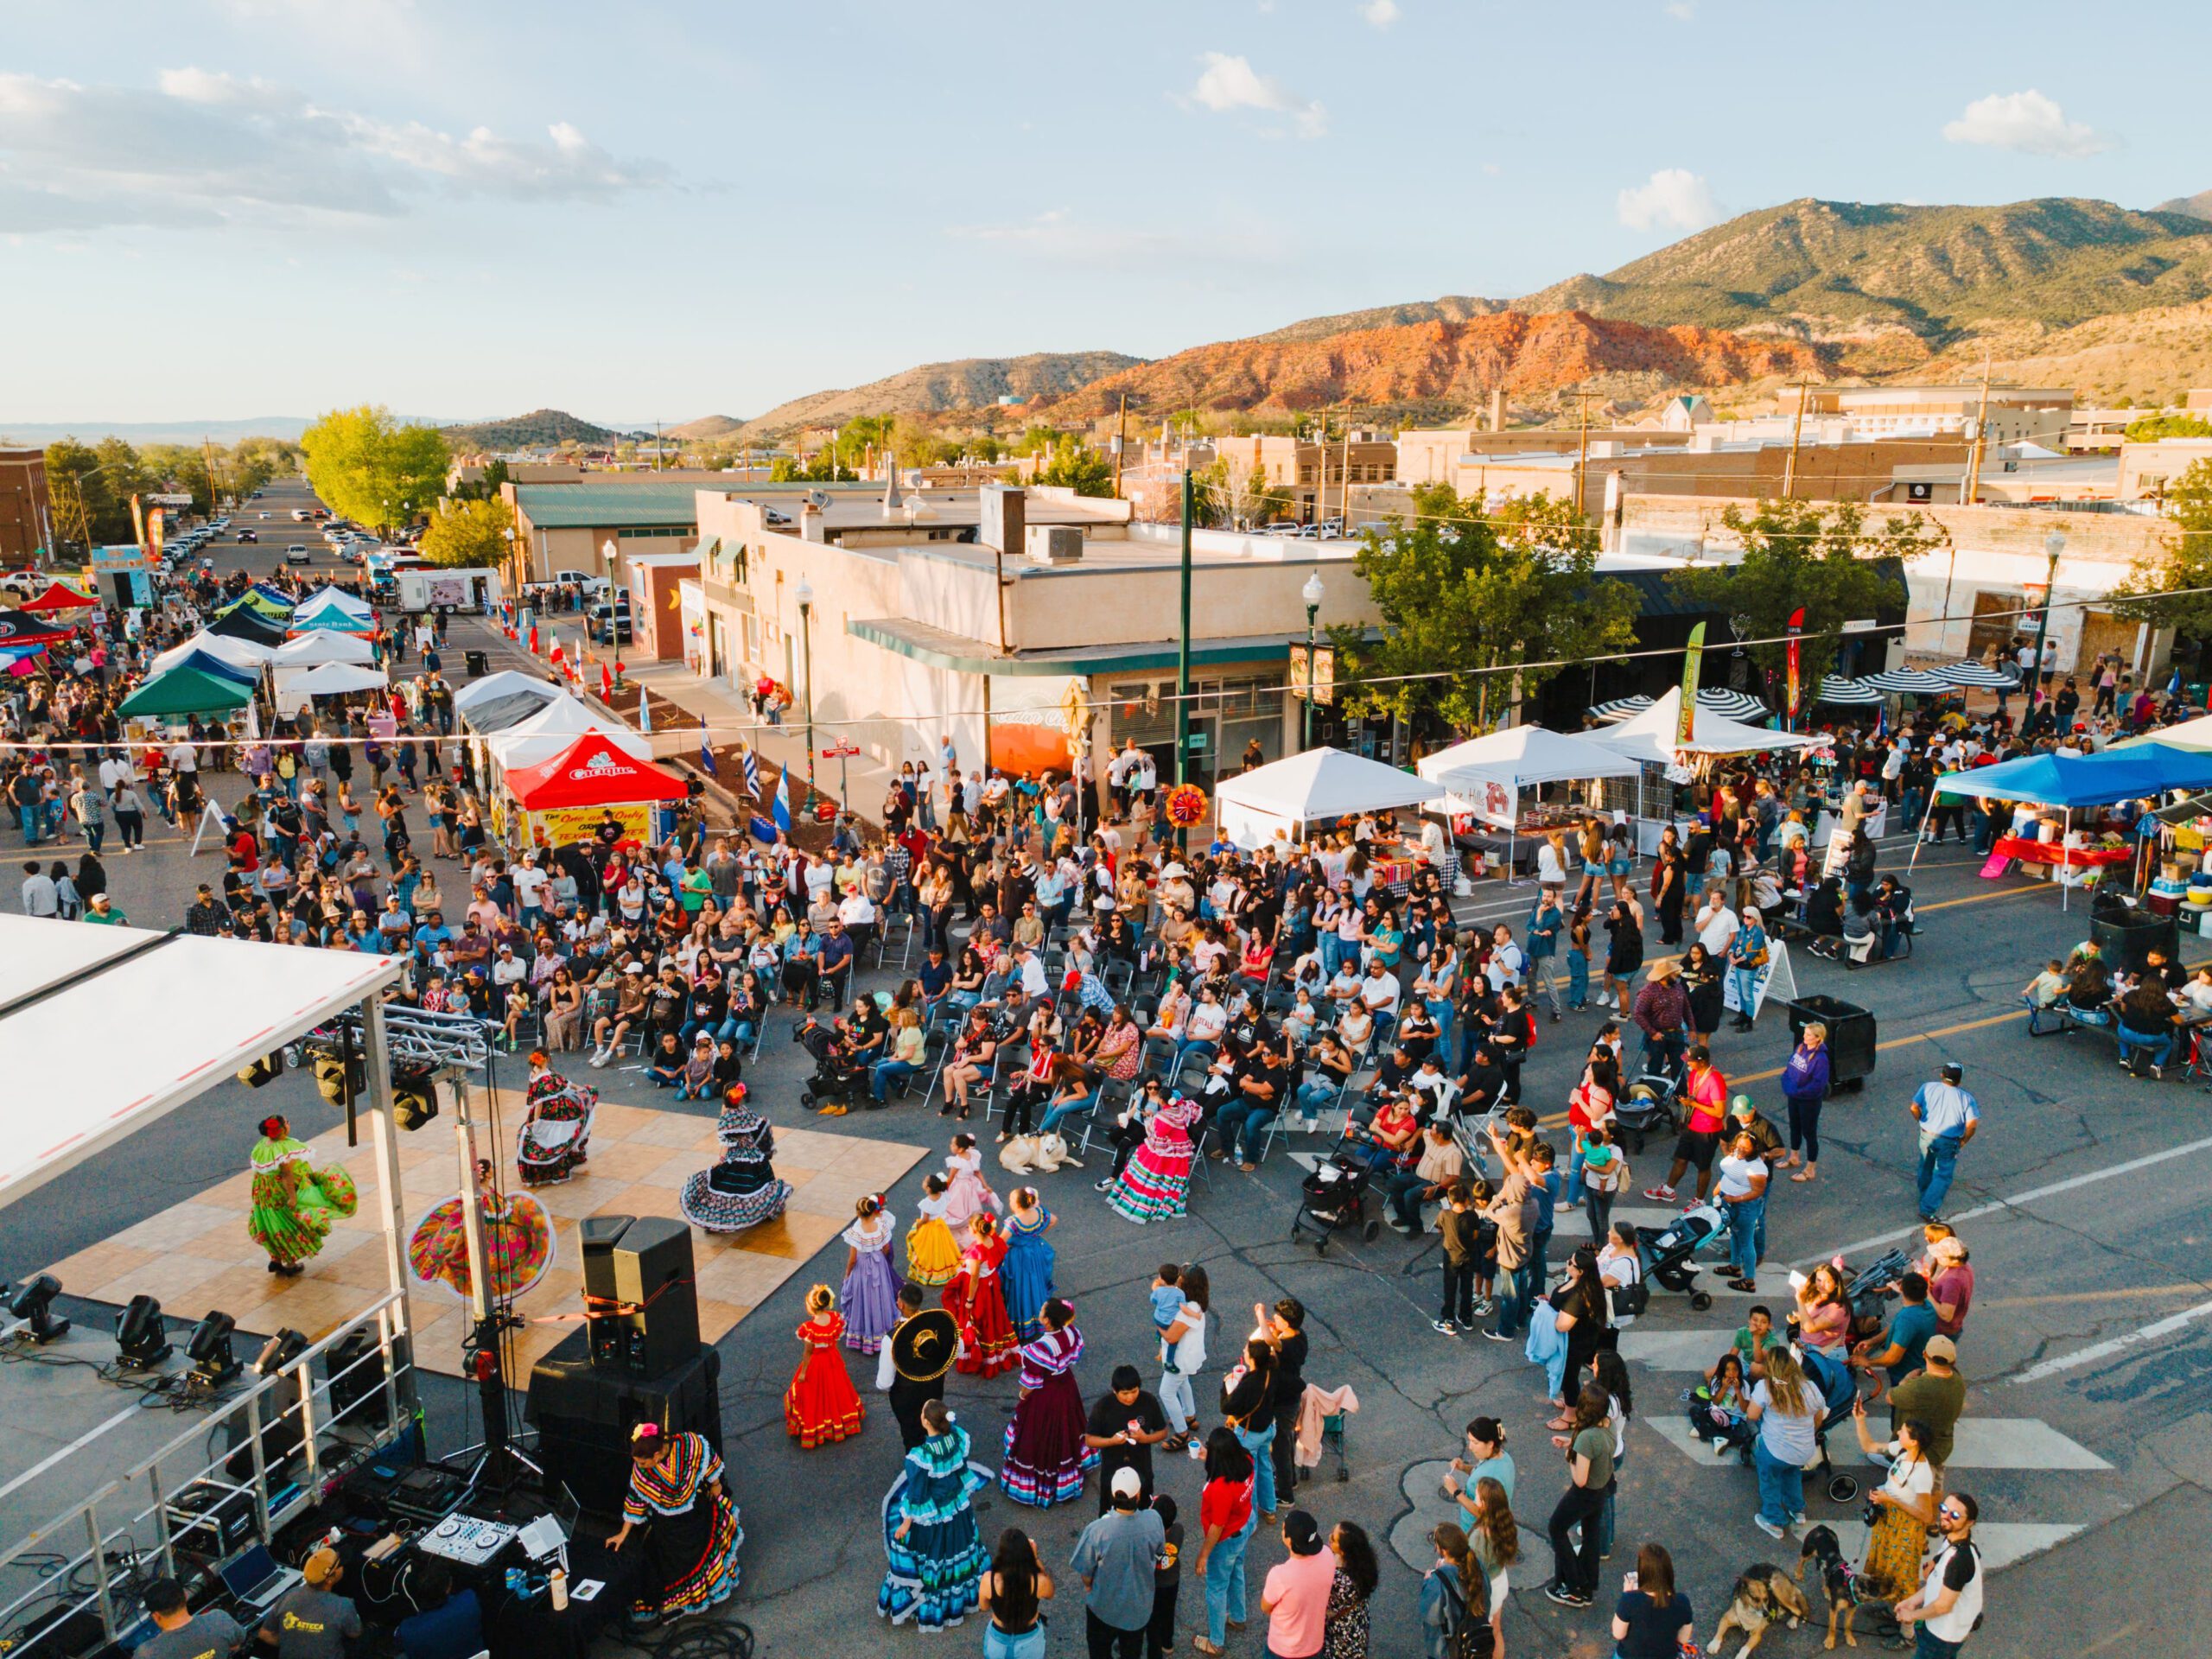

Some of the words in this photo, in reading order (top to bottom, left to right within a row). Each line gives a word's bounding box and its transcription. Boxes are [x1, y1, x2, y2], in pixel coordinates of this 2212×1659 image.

[995, 708, 1043, 725] Cedar
[569, 766, 638, 780] Cacique
[1469, 787, 1484, 806] Hills
[544, 813, 560, 822] The
[560, 814, 584, 823] One
[614, 810, 644, 820] Only
[559, 832, 594, 841] TEXAS
[296, 1620, 325, 1631] AZTECA
